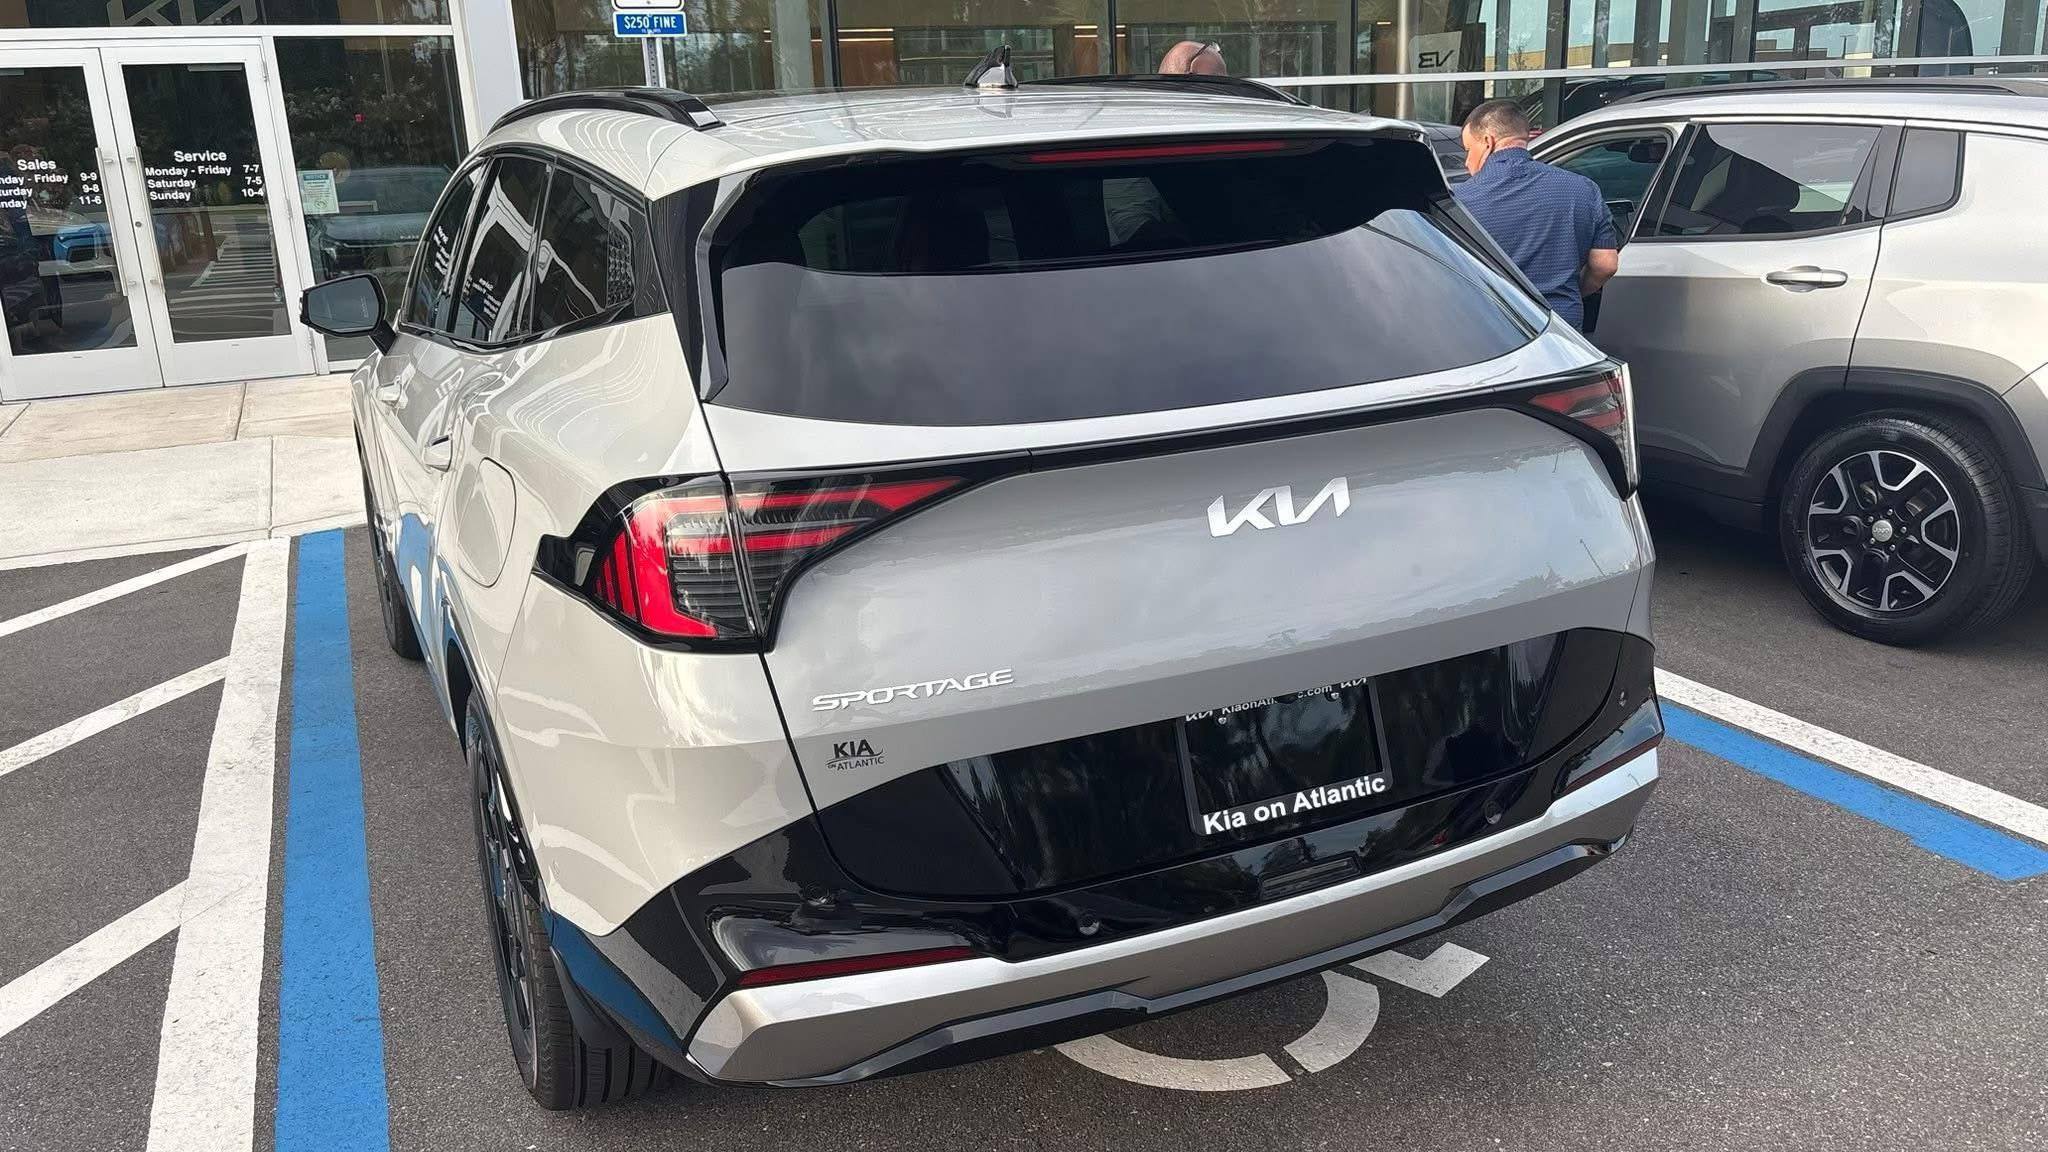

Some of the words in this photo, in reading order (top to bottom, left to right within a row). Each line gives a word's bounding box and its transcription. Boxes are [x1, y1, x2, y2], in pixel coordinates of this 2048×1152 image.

[624, 15, 650, 29] $250
[653, 16, 677, 29] FINE
[174, 150, 227, 162] Service
[17, 158, 57, 171] Sales
[145, 166, 188, 177] Monday
[197, 164, 232, 176] Friday
[242, 164, 260, 173] 7-7
[34, 173, 69, 184] Friday
[79, 171, 97, 181] 9-9
[147, 178, 197, 189] Saturday
[244, 176, 263, 185] 7-5
[82, 183, 100, 193] 9-8
[149, 190, 191, 201] Sunday
[241, 188, 264, 197] 10-4
[79, 196, 102, 205] 11-6
[1207, 476, 1352, 538] KIA
[812, 668, 1015, 712] SPORTAGE
[833, 739, 875, 760] KIA
[837, 756, 885, 771] ATLANTIC
[1203, 809, 1247, 835] Kia
[1253, 801, 1286, 822] on
[1293, 776, 1386, 813] Atlantic
